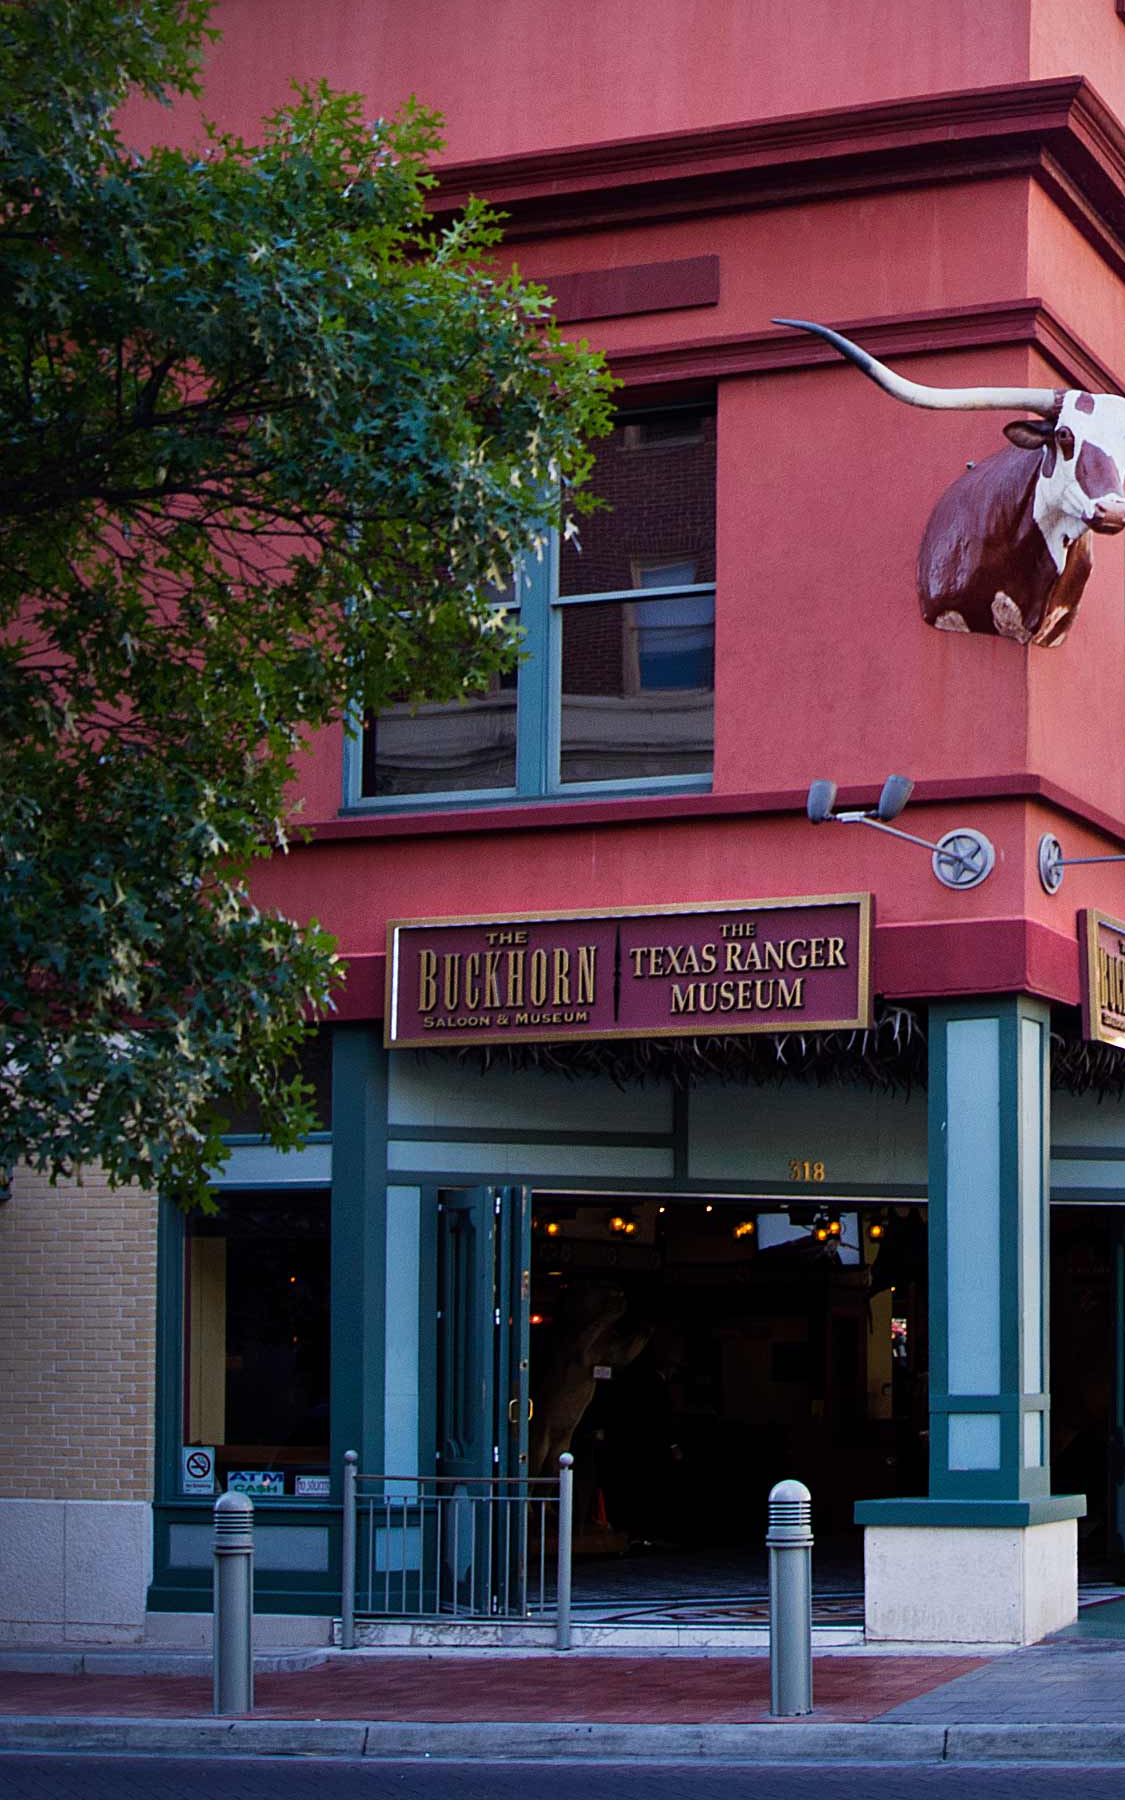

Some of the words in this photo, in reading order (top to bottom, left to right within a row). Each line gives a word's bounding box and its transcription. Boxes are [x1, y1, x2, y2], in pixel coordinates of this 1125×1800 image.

[487, 931, 528, 946] THE
[720, 923, 756, 938] THE
[629, 943, 717, 977] TEXAS
[724, 937, 847, 973] RANGER
[418, 946, 597, 1012] BUCKHORN
[670, 978, 804, 1014] MUSEUM
[423, 1015, 490, 1028] SALOON
[496, 1015, 509, 1026] &
[515, 1011, 588, 1025] MUSEUM
[788, 1160, 825, 1182] 318
[229, 1472, 284, 1481] ATM
